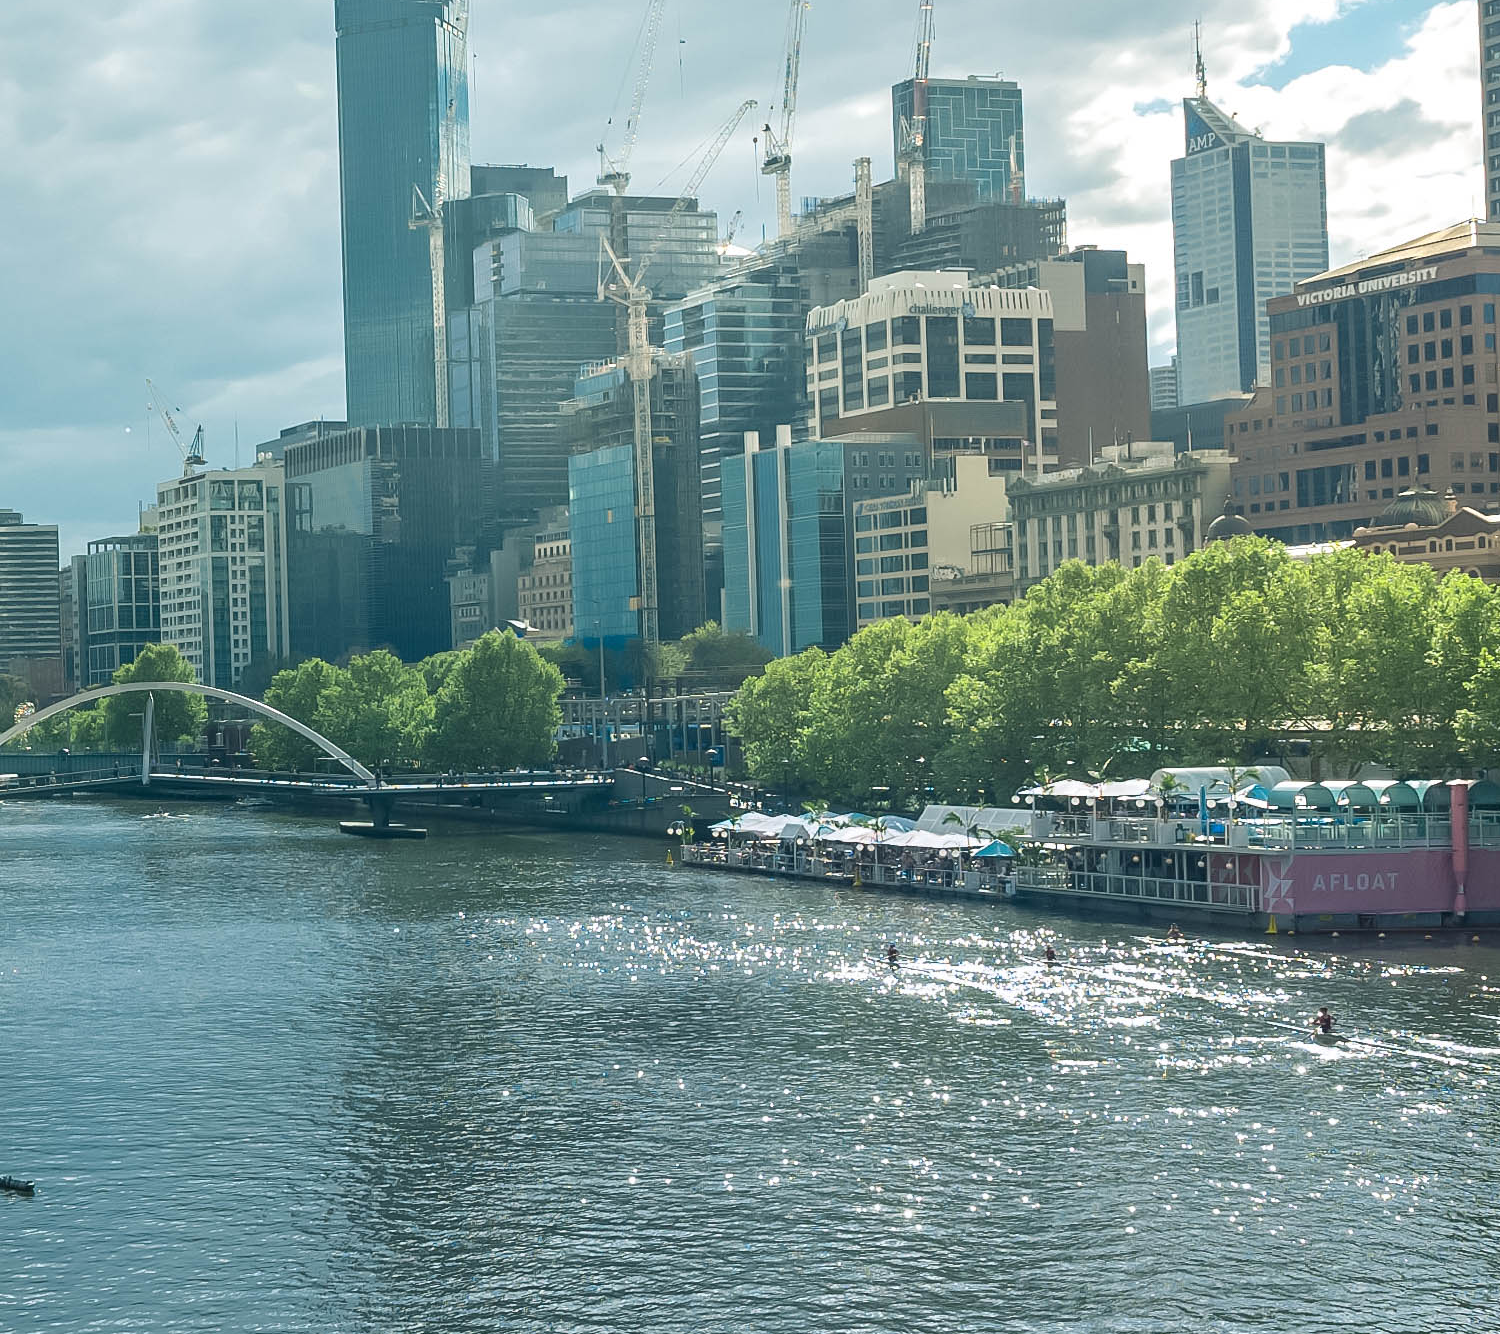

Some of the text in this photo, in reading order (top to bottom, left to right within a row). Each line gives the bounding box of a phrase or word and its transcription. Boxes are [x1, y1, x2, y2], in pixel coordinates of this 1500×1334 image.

[1189, 132, 1216, 153] AMP
[1296, 265, 1439, 307] VICTORIA UNIVERSITY
[909, 303, 960, 317] challenger
[1311, 872, 1399, 892] AFLOAT
